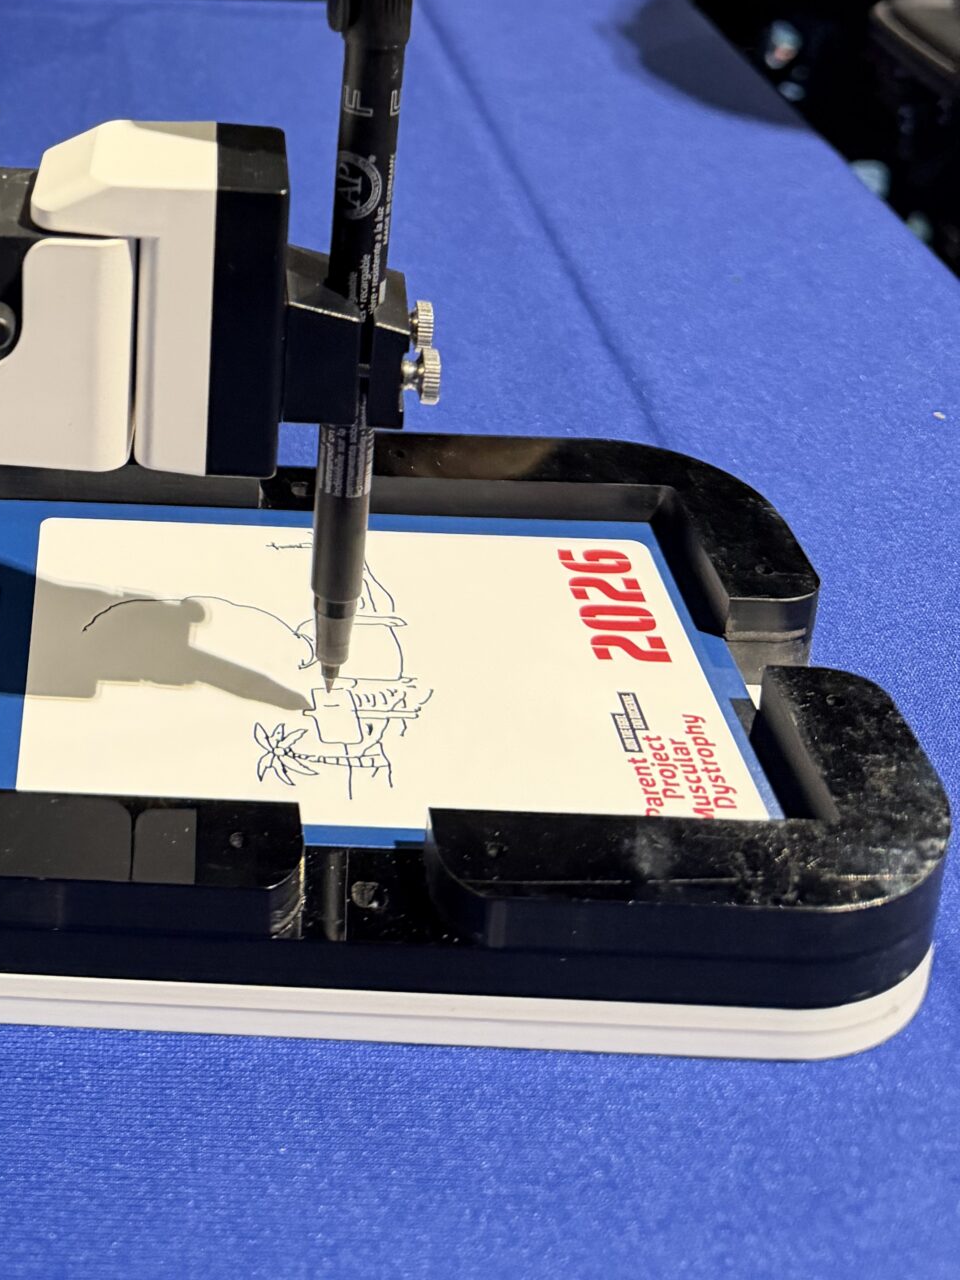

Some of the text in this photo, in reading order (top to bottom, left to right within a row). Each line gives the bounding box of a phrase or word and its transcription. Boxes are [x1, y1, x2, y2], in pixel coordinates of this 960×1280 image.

[359, 254, 372, 303] recargable
[557, 549, 673, 663] 2026
[628, 757, 664, 817] Parent
[642, 735, 686, 800] Project
[669, 738, 715, 820] Muscular
[682, 713, 738, 809] Dystrophy
